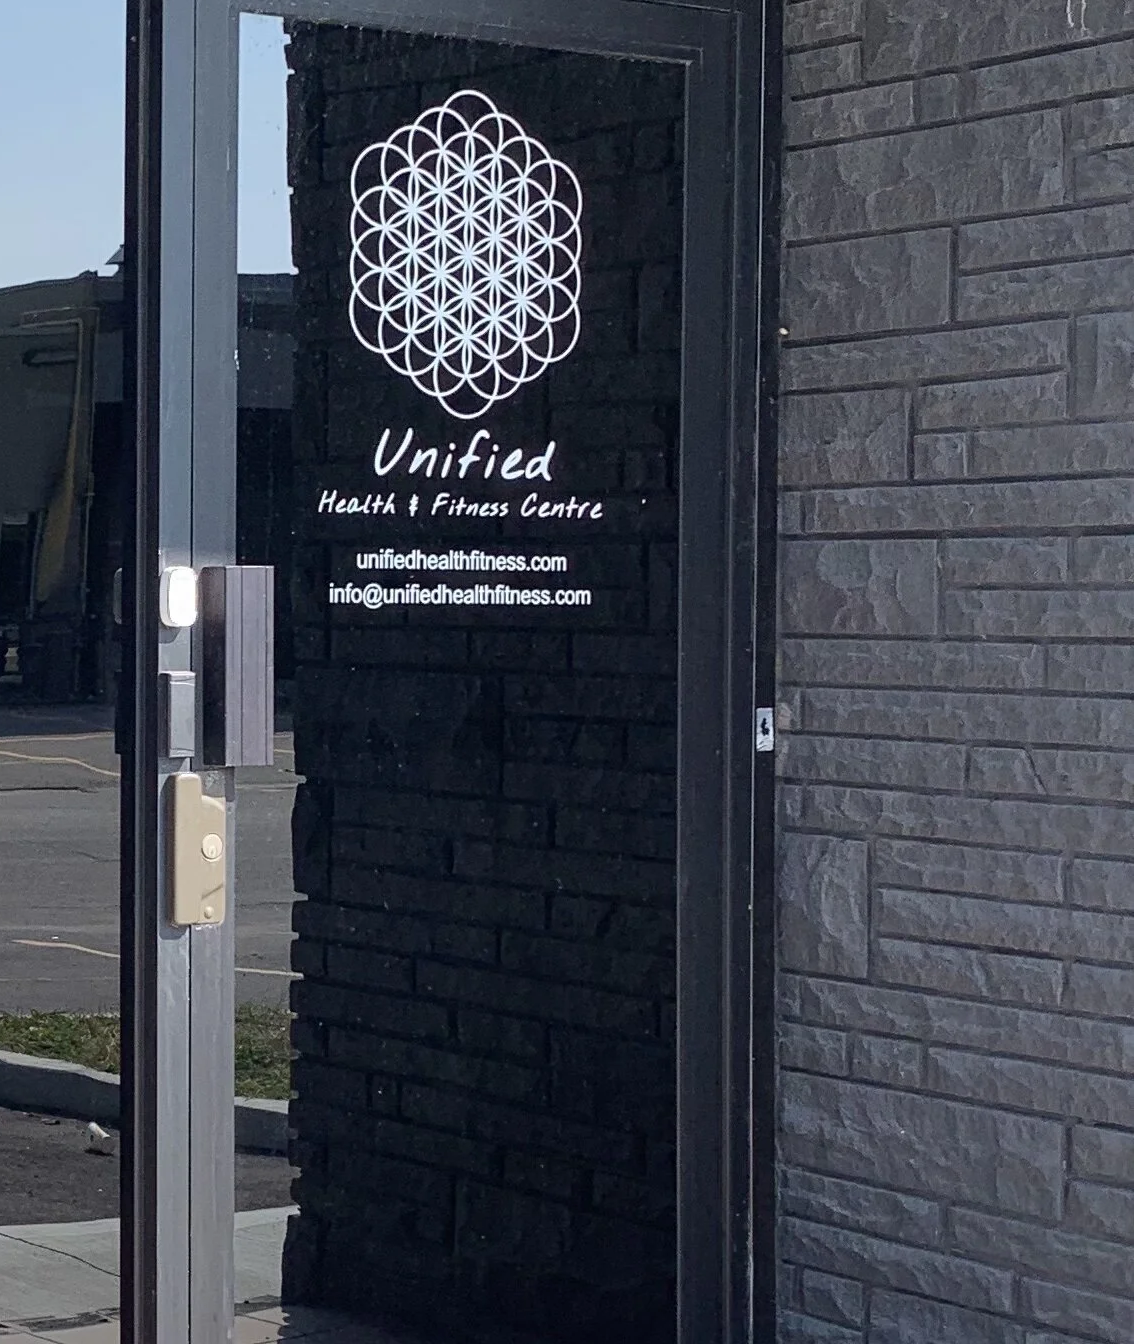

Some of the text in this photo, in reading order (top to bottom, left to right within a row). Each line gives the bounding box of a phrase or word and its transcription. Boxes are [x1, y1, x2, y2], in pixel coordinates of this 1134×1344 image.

[374, 428, 556, 481] Unified
[318, 490, 395, 514] Health
[431, 493, 509, 518] Fitness
[520, 493, 604, 519] Centre
[356, 549, 567, 572] unifiedhealthfitness.com
[329, 583, 592, 609] info@unifiedhealthfitness.com
